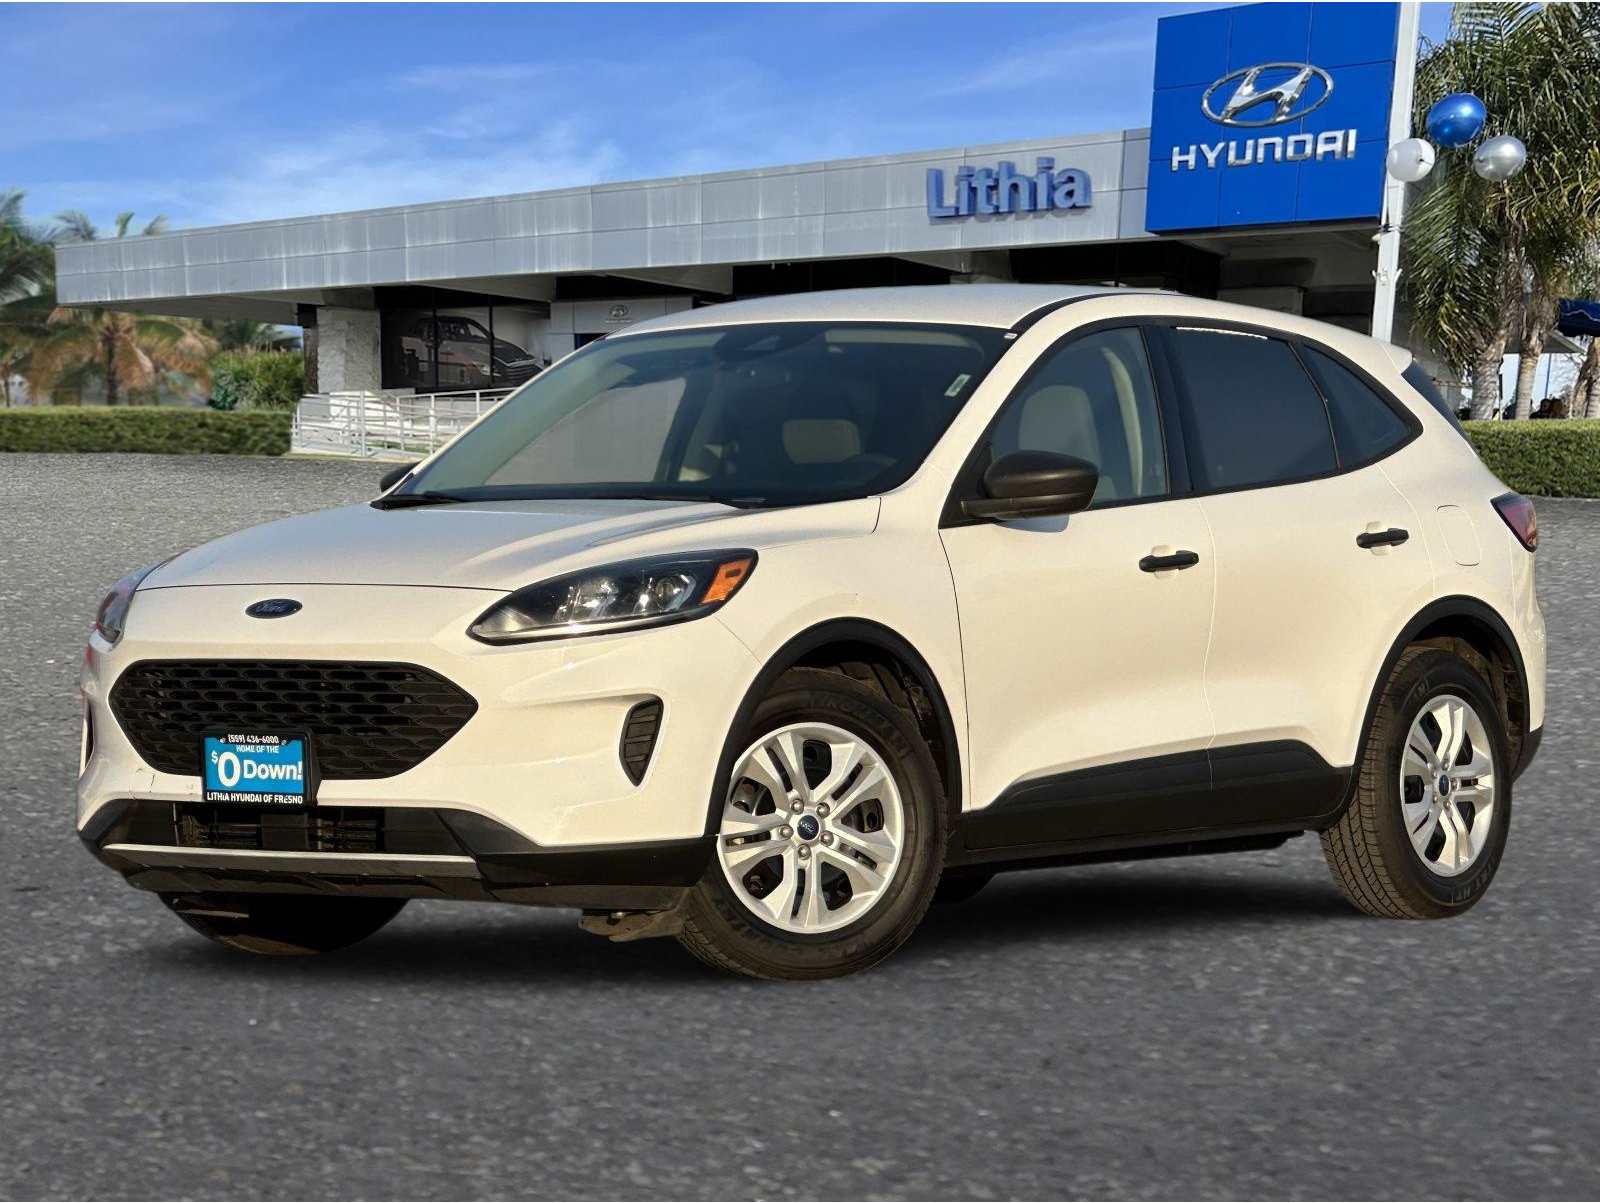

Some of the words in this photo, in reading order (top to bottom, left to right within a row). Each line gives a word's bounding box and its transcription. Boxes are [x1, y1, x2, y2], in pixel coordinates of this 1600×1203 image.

[1171, 128, 1357, 172] HYUNDAI
[927, 156, 1092, 218] Lithia
[228, 734, 245, 744] (559)
[246, 735, 279, 744] 436-6000
[236, 744, 255, 753] HOME
[256, 745, 265, 753] OF
[266, 745, 279, 753] THE
[243, 759, 303, 780] Down!
[230, 793, 262, 803] HYUNDAI
[263, 794, 273, 803] OF
[274, 795, 303, 804] FRESNO
